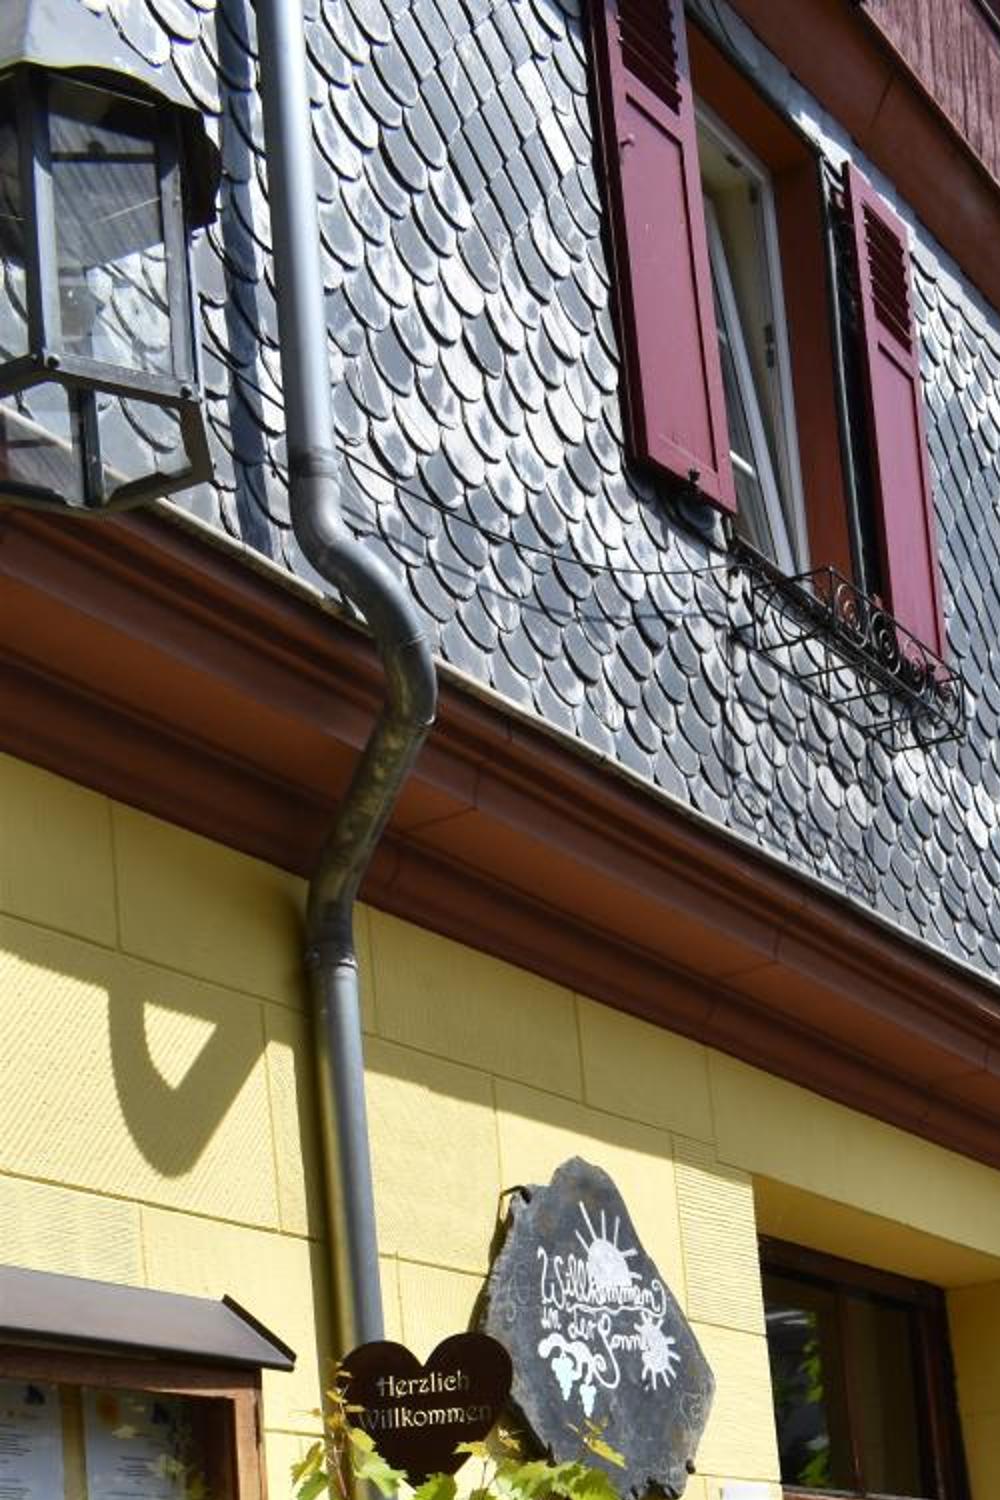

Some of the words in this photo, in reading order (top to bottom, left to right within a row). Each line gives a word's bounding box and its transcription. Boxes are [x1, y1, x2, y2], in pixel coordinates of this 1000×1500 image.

[537, 1247, 661, 1311] Willkommen
[567, 1309, 597, 1341] der
[376, 1369, 470, 1399] Herzlich
[358, 1406, 492, 1431] Willkommen
